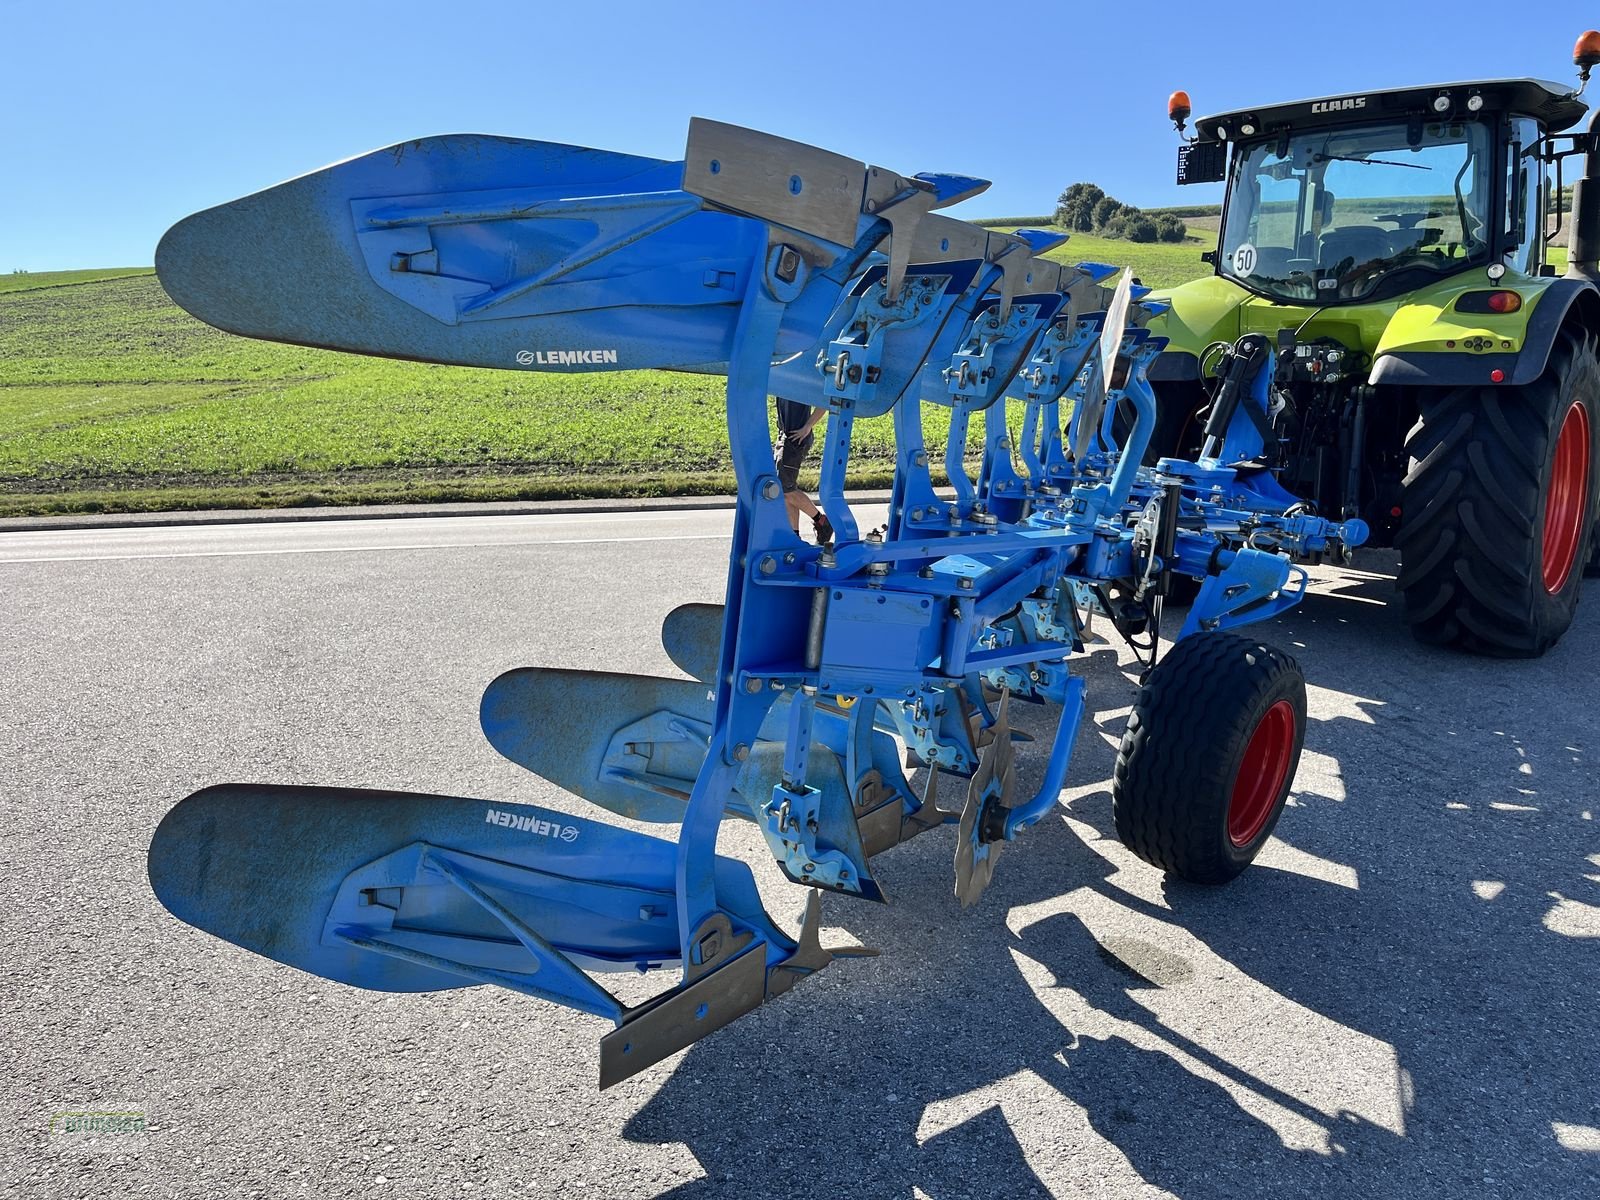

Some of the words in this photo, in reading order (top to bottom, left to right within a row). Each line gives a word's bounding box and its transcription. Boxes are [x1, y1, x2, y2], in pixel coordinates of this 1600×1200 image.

[1311, 97, 1366, 114] CLAAS
[1237, 249, 1253, 272] 50
[536, 350, 618, 367] LEMKEN
[485, 808, 561, 838] LEMKEN
